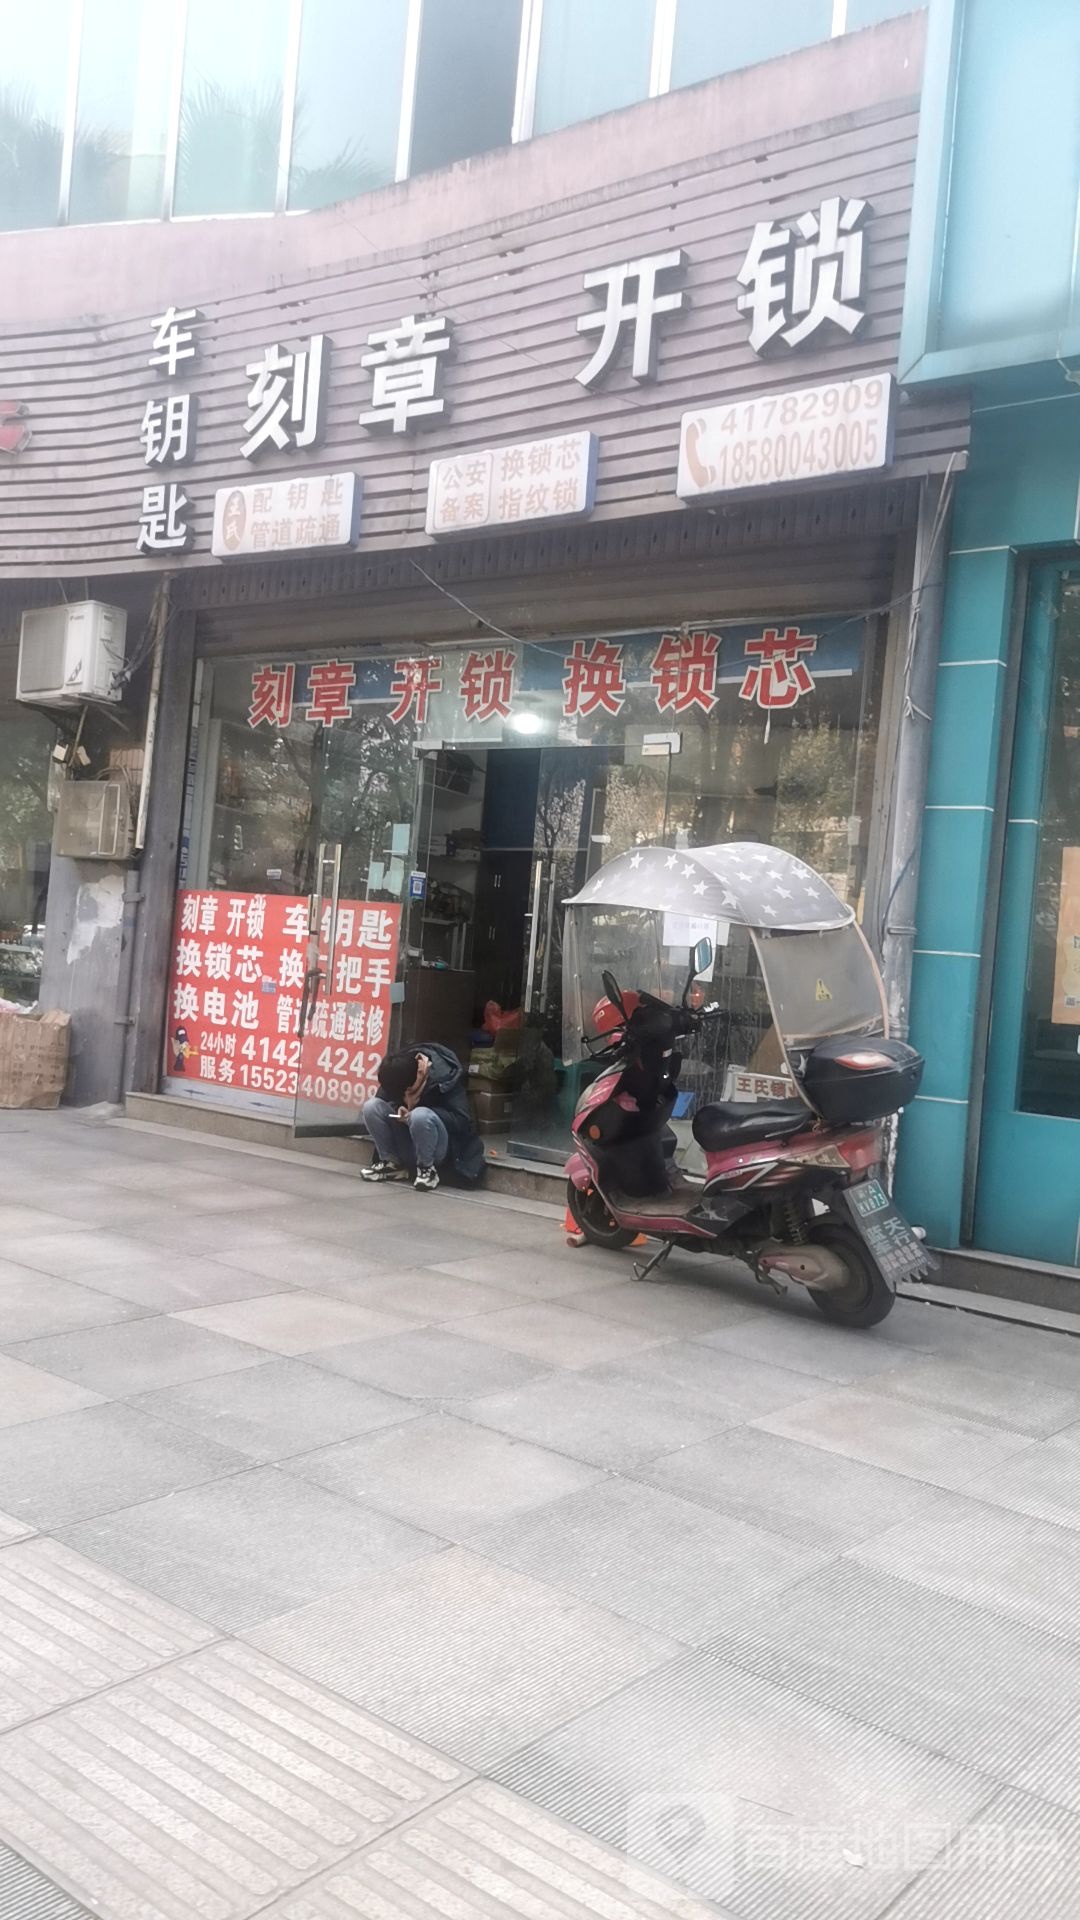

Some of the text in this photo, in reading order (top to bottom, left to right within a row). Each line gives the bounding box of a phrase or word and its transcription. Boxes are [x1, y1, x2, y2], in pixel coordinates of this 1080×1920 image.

[240, 196, 869, 458] 刻章 开锁
[136, 306, 197, 551] 车钥匙
[720, 380, 883, 435] 41782909
[442, 460, 487, 489] 公安
[501, 438, 581, 481] 换锁芯
[720, 418, 878, 486] 18580043005
[252, 478, 343, 514] 配钥匙
[440, 493, 484, 523] 备案
[499, 477, 578, 520] 指纹锁
[251, 513, 341, 548] 管道疏通
[248, 627, 817, 728] 刻章 开锁 换锁芯
[181, 894, 394, 950] 刻章 开锁 车钥匙
[176, 938, 391, 998] 换锁芯 换把手
[173, 982, 260, 1029] 换电池
[200, 1030, 237, 1057] 24小时
[241, 1034, 303, 1068] 4142
[200, 1055, 236, 1083] 服务
